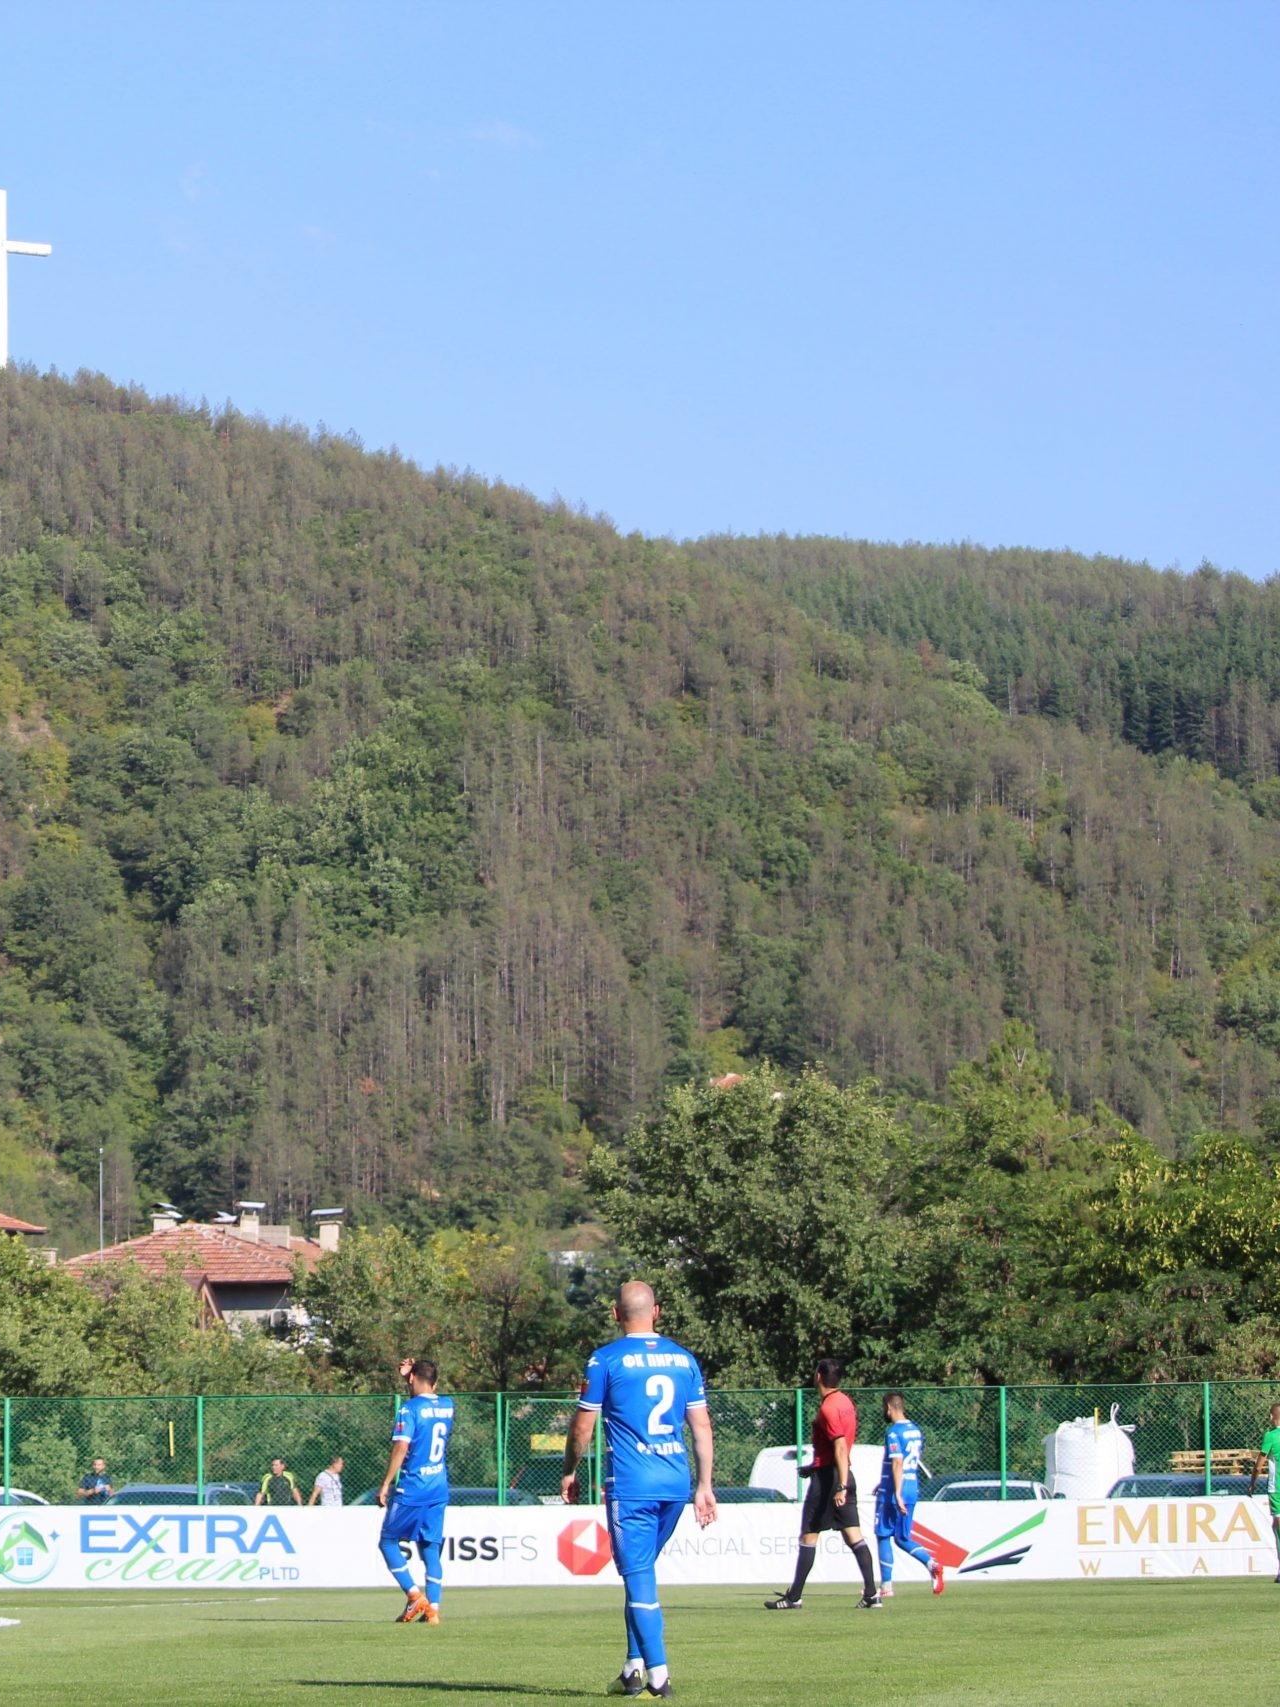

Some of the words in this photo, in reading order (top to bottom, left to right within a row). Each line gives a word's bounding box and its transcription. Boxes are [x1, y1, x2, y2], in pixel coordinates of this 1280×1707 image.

[623, 1354, 644, 1368] ФК
[646, 1374, 674, 1435] 2
[429, 1422, 446, 1462] 6
[80, 1514, 296, 1554] EXTRA
[1077, 1502, 1269, 1545] EMIRA
[84, 1528, 261, 1582] clean
